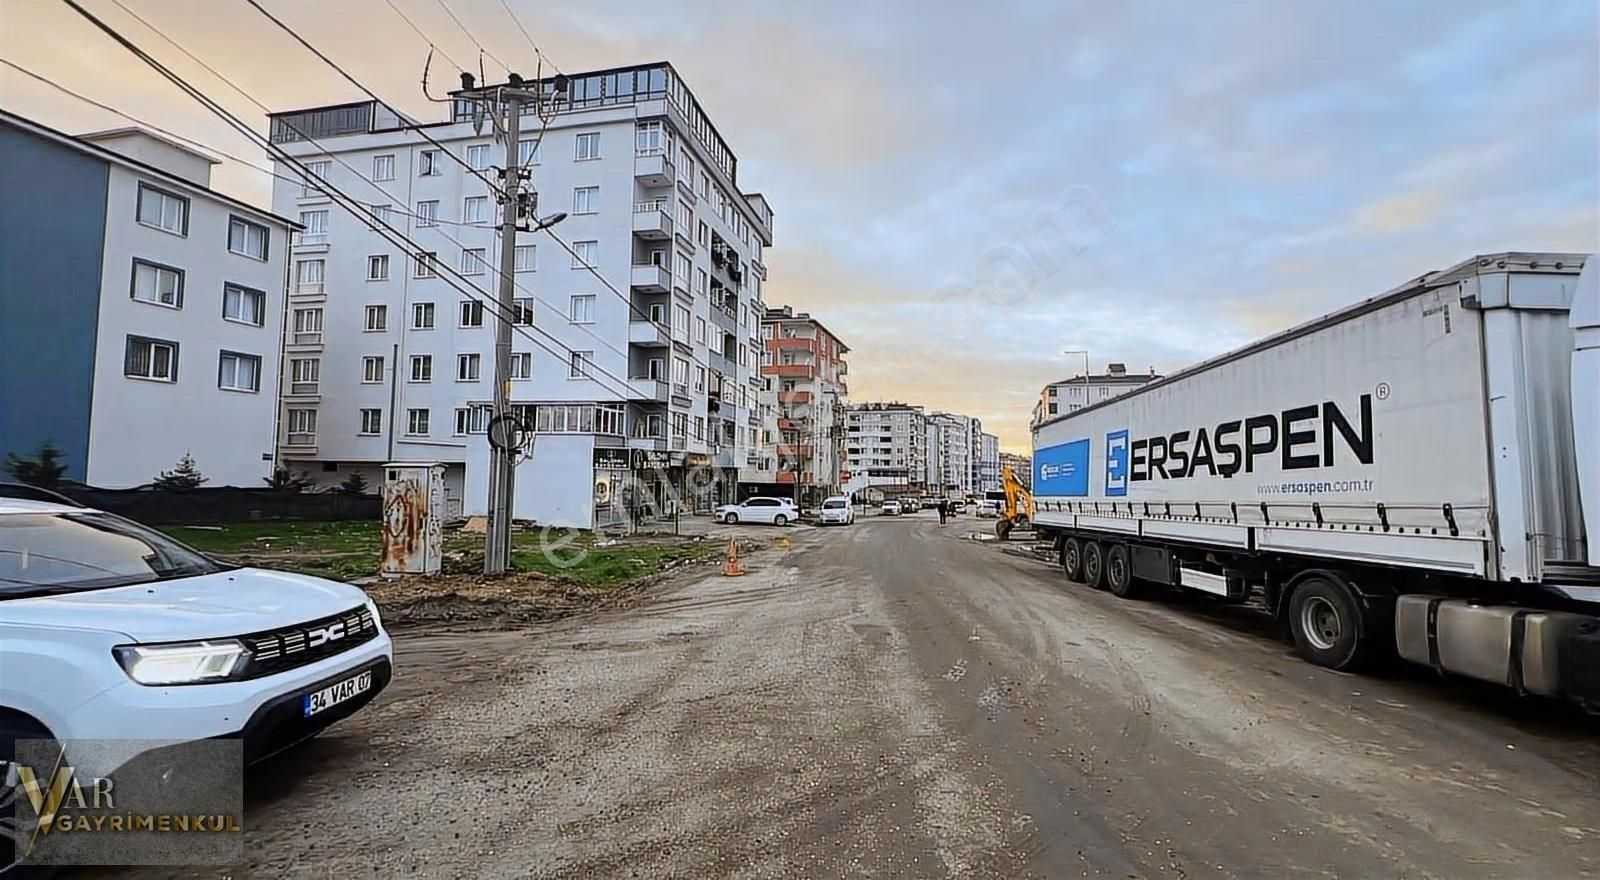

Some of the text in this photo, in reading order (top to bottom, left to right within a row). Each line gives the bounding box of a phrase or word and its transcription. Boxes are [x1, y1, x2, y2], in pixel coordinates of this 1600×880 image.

[1130, 394, 1374, 481] ERSAŞPEN
[312, 691, 327, 712] 34
[331, 679, 355, 703] VAR
